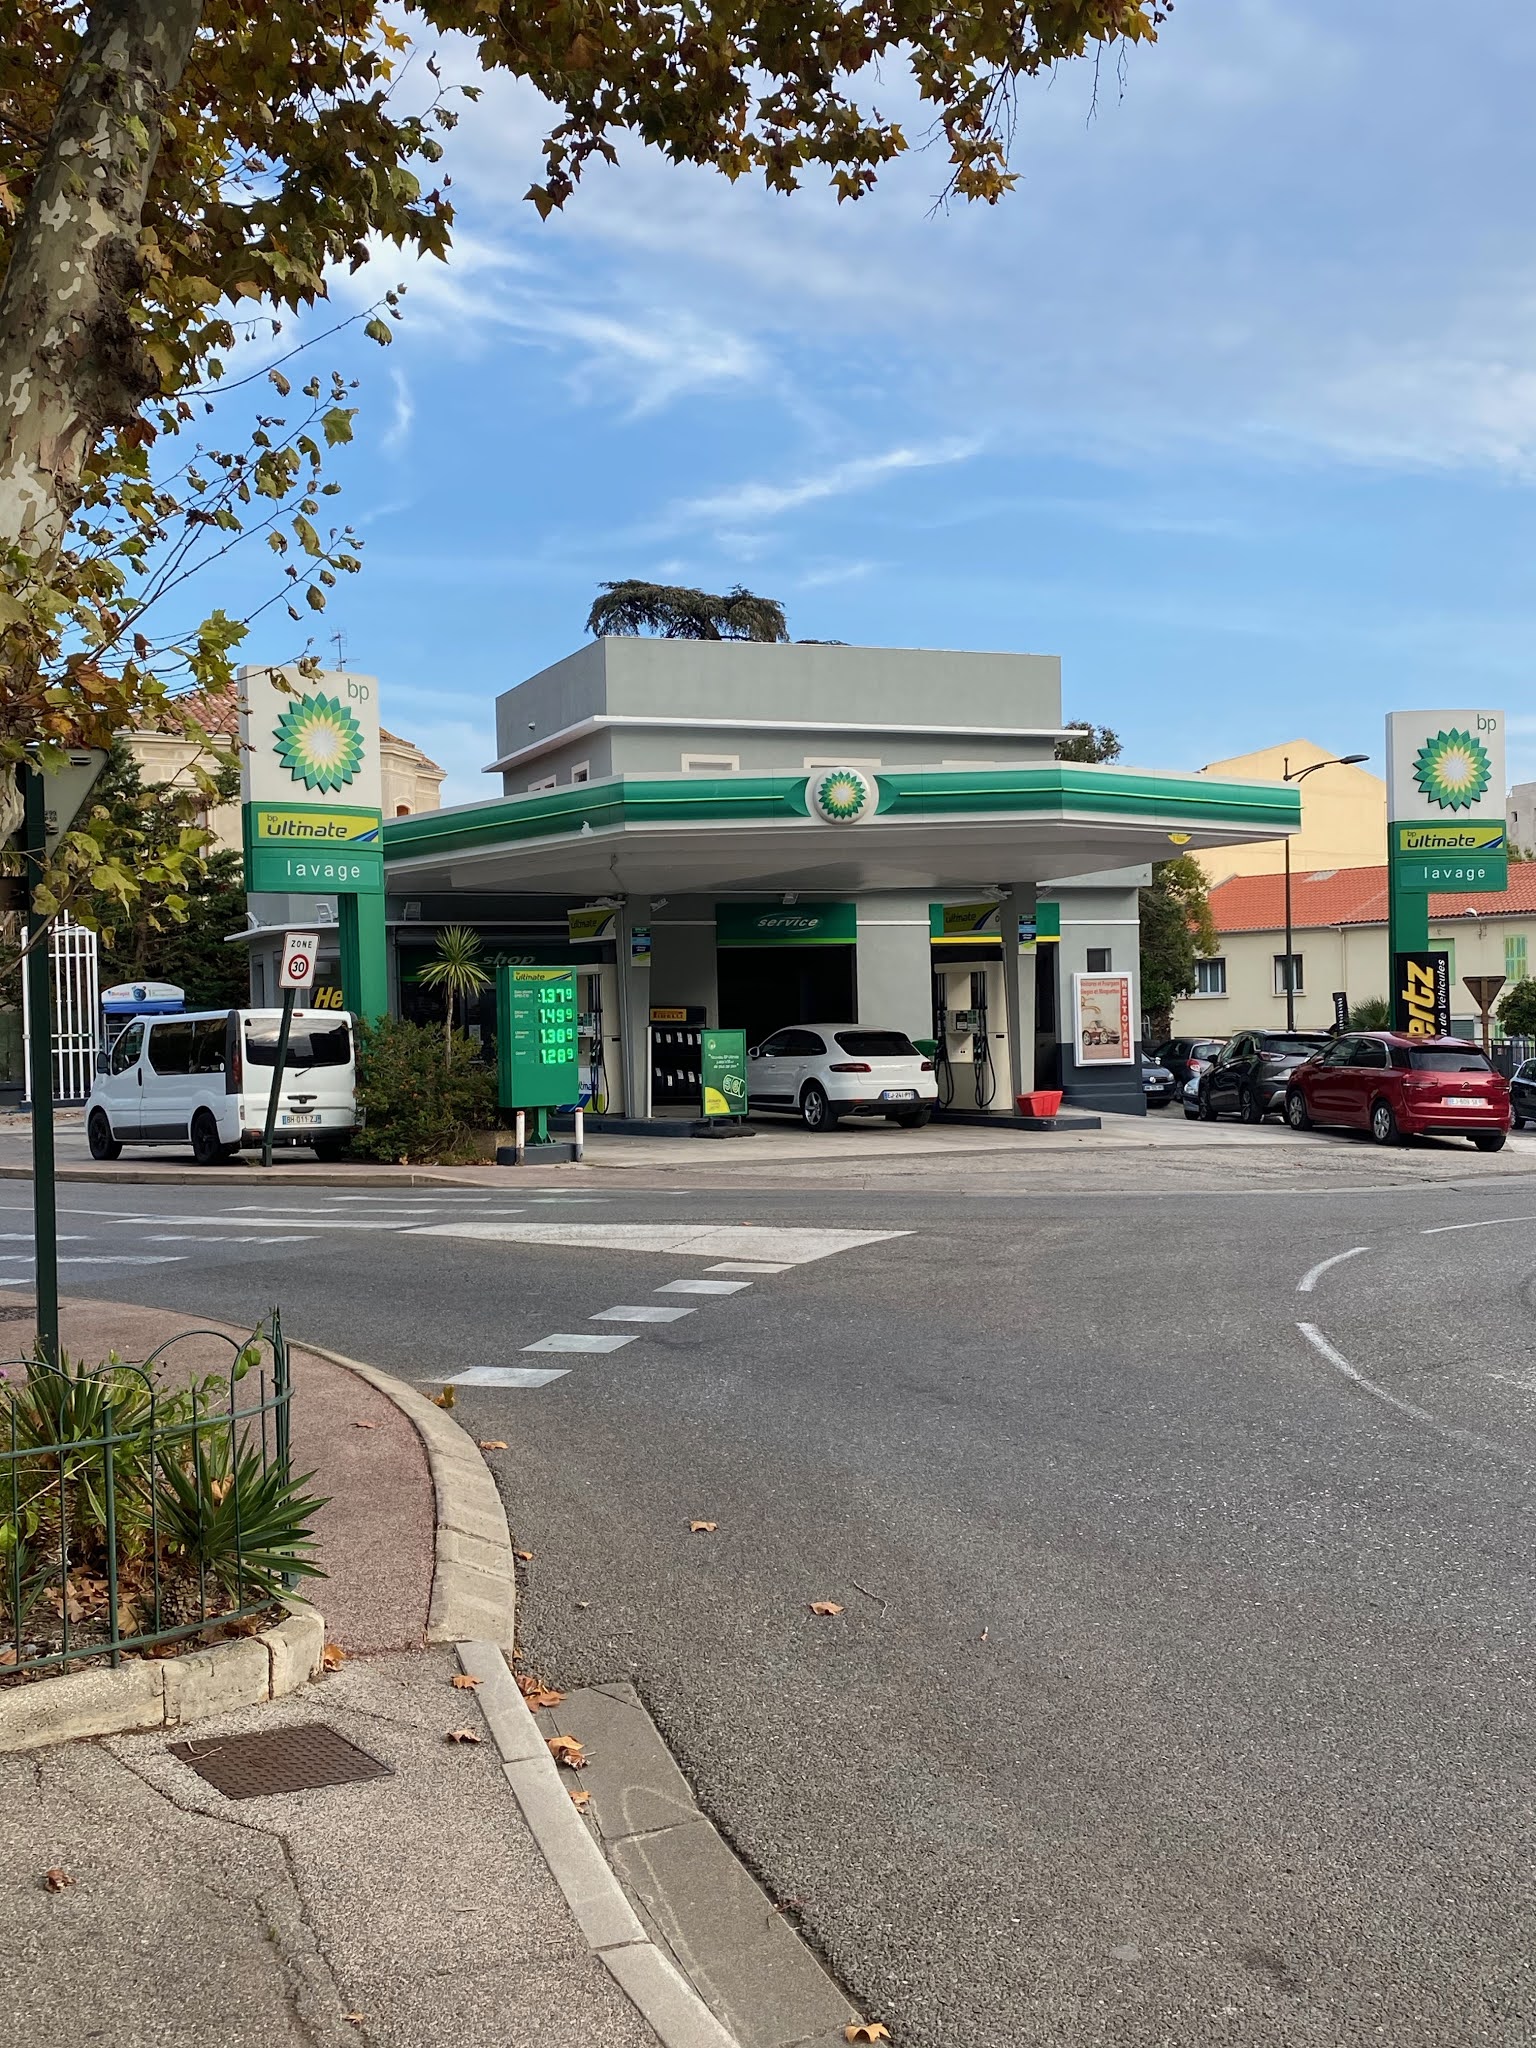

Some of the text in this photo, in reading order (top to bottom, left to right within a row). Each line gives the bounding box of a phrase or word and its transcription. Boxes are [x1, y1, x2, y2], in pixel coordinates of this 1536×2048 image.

[347, 678, 370, 704] bp
[1477, 714, 1497, 734] bp
[266, 814, 278, 823] bp
[267, 820, 347, 838] ultimate
[1407, 831, 1417, 839] bp
[1407, 834, 1476, 848] ultimate
[287, 860, 360, 881] lavage
[1424, 867, 1486, 880] lavage
[758, 918, 819, 926] service
[291, 940, 312, 948] ZONE
[480, 952, 536, 965] shop
[292, 962, 304, 973] 30
[515, 973, 546, 981] ultimate
[313, 987, 344, 1009] He
[1121, 980, 1129, 1057] NETTOYAGE
[1439, 1012, 1447, 1026] de
